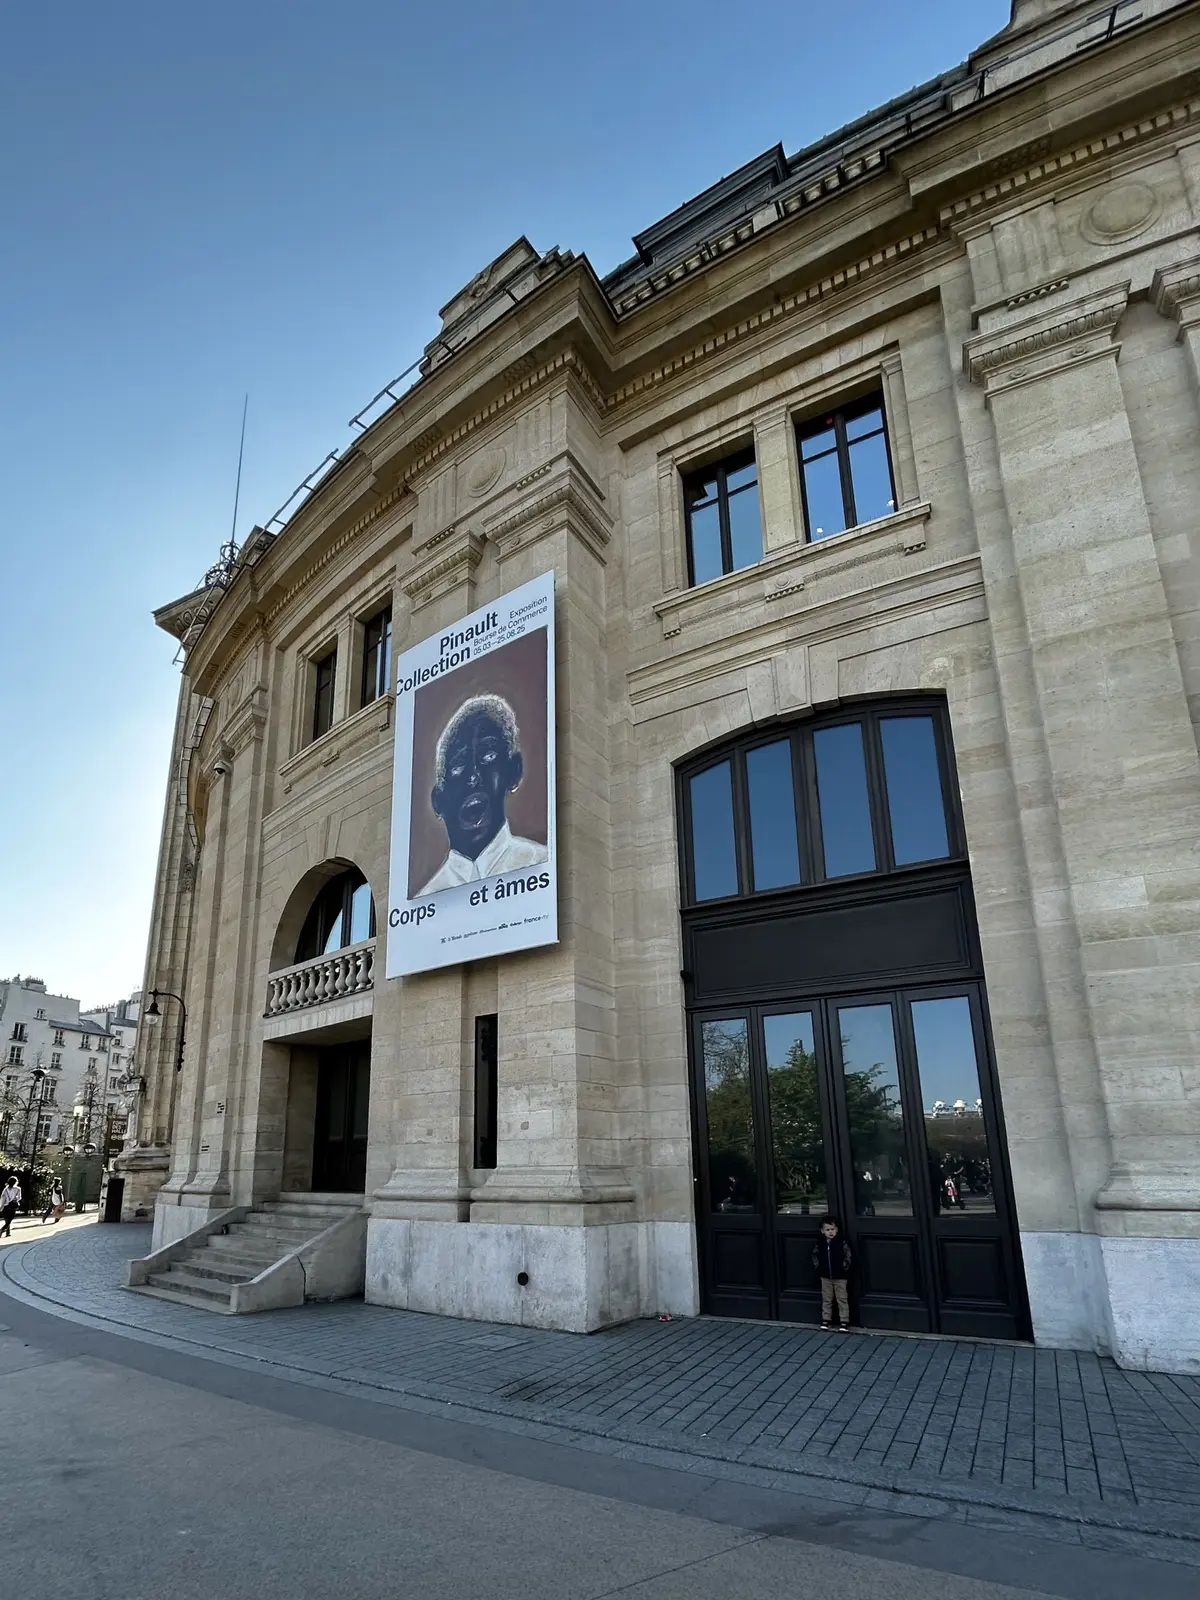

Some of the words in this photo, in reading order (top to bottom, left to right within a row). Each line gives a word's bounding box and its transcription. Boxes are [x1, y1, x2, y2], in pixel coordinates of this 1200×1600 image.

[473, 630, 497, 647] Bourse
[497, 625, 507, 634] de
[507, 605, 548, 629] Commerce
[509, 596, 548, 619] Exposition
[440, 611, 498, 656] Pinault
[396, 646, 471, 696] Collection
[389, 902, 436, 928] Corps
[469, 885, 489, 906] et
[494, 872, 550, 900] âmes
